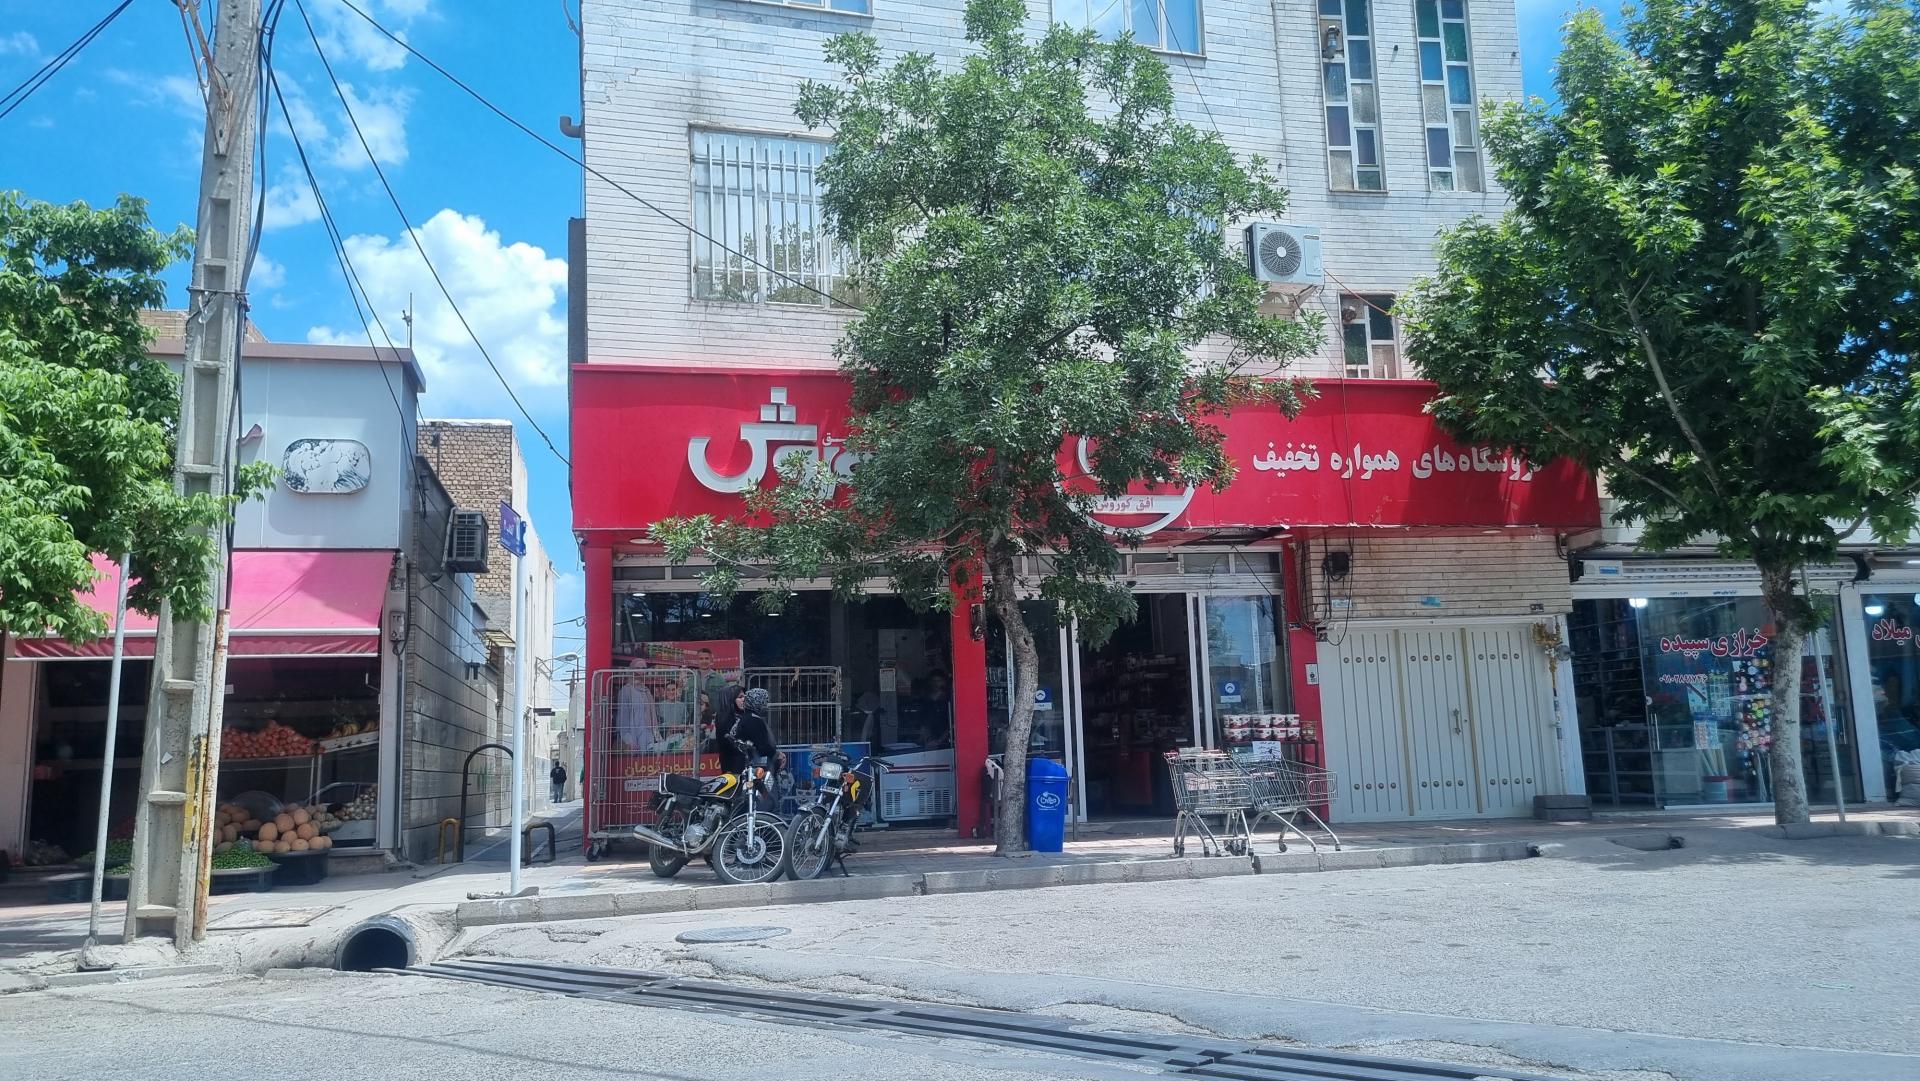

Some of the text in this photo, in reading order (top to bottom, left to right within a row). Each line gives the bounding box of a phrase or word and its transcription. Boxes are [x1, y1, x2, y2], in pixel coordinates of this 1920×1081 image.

[1252, 441, 1320, 478] تخفیف
[1330, 443, 1400, 480] همواره
[1136, 497, 1154, 511] افق
[1660, 628, 1768, 659] خرازی سپیده
[1872, 618, 1912, 646] میلاد
[624, 761, 661, 777] تومان
